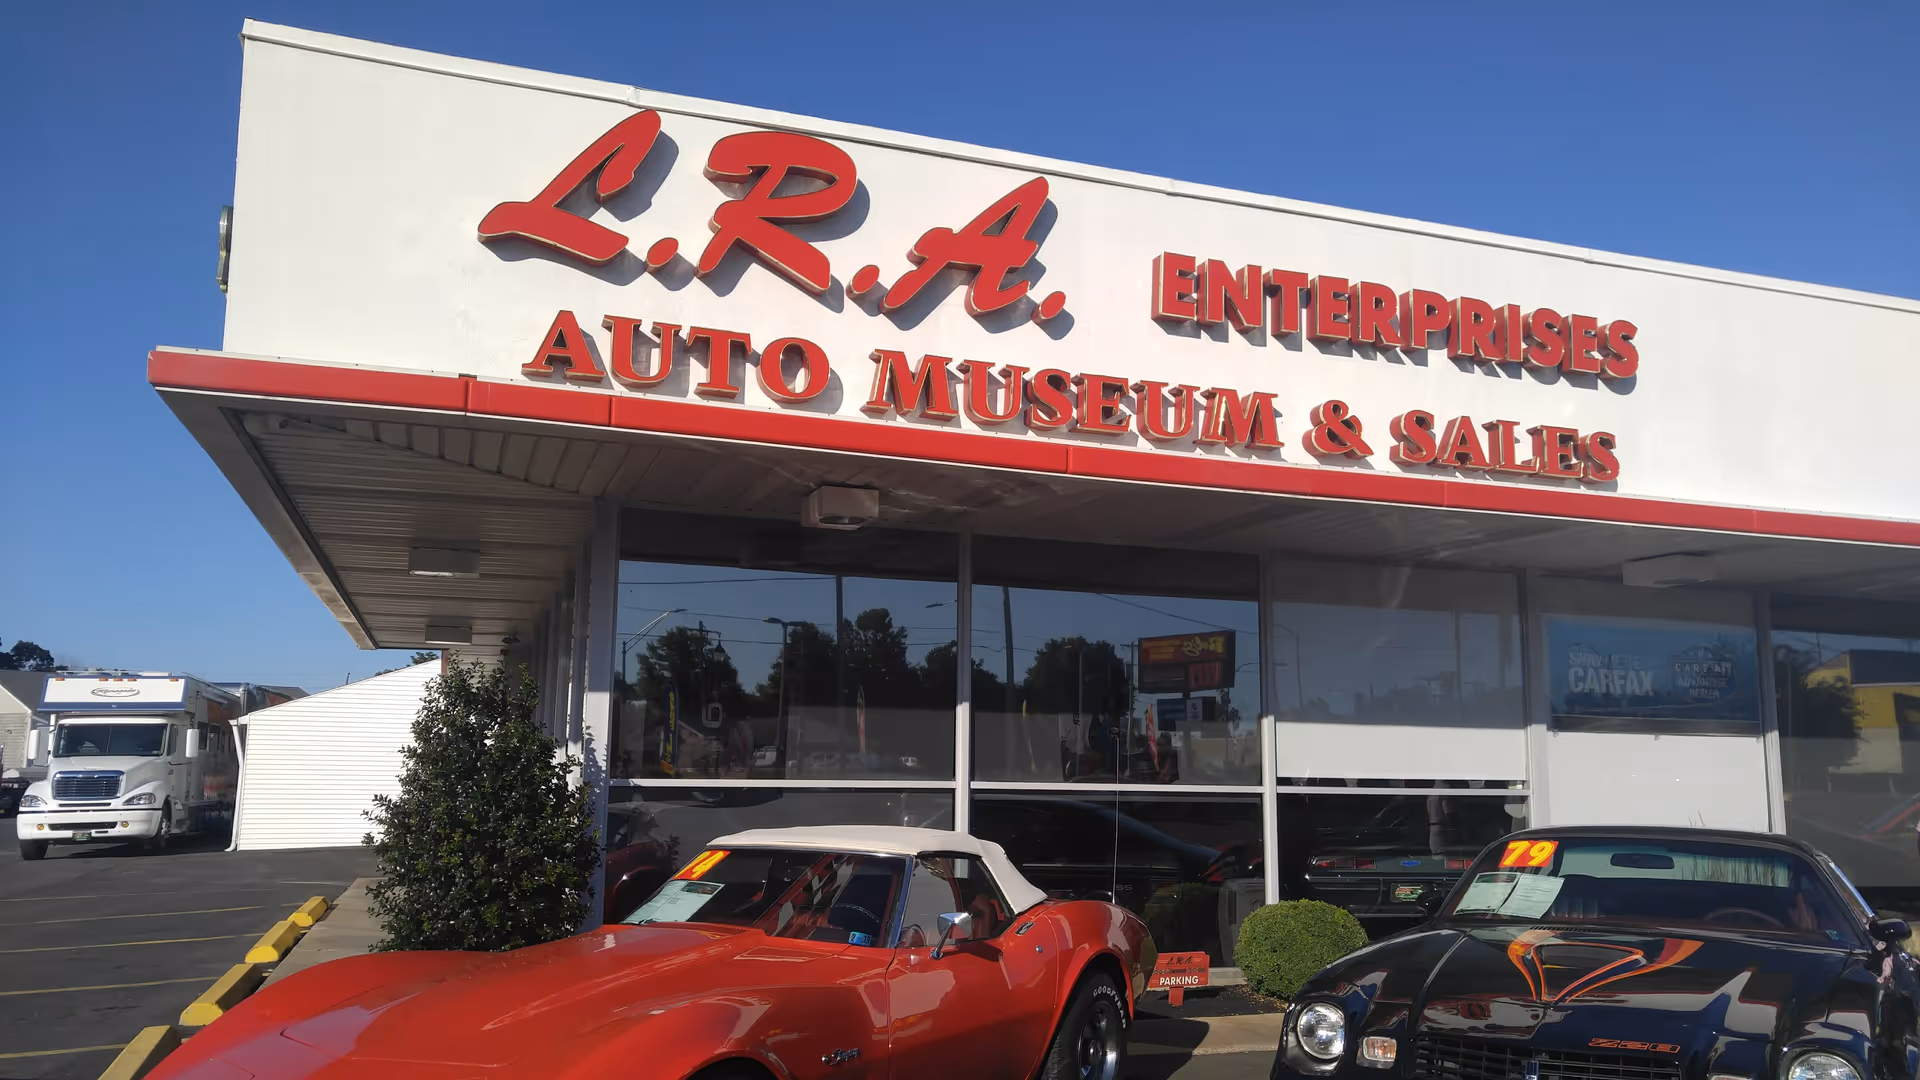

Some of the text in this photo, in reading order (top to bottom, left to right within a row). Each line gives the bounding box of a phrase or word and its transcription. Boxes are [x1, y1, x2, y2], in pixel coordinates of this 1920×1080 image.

[1151, 251, 1639, 379] ENTERPRISES
[521, 309, 1620, 484] AUTO MUSEUM & SALES
[1568, 667, 1656, 697] CARFAX
[1503, 841, 1555, 866] 79
[1159, 976, 1199, 986] PARKING
[1092, 985, 1127, 1029] GOODYEAR
